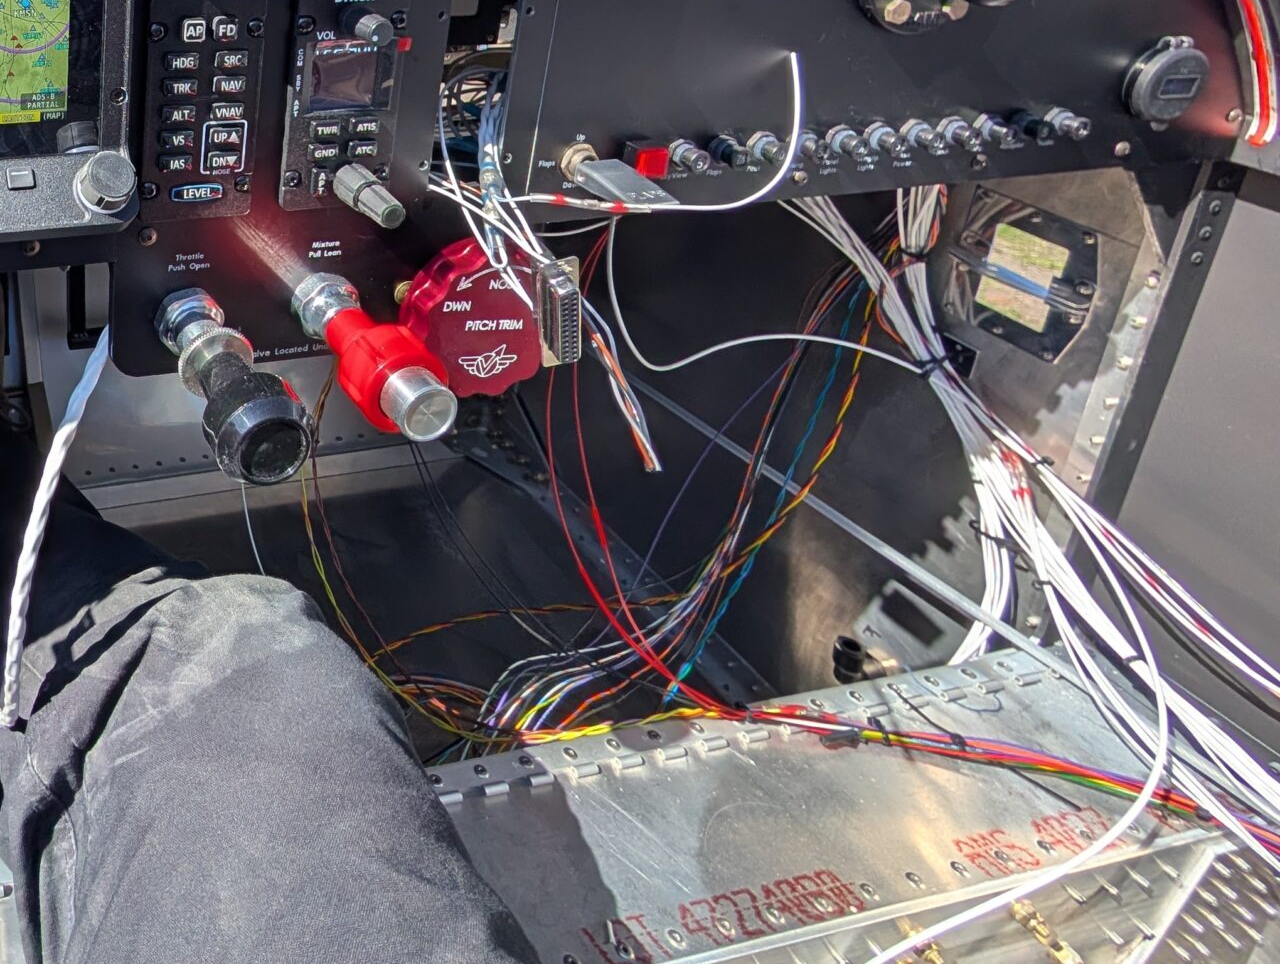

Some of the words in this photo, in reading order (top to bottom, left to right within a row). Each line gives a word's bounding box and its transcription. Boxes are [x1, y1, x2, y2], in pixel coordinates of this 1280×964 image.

[186, 26, 203, 37] AP
[219, 24, 236, 36] FD
[316, 31, 337, 41] VOL
[172, 56, 195, 69] HDG
[224, 54, 242, 66] SRC
[296, 48, 304, 67] COM
[173, 83, 191, 94] TRK
[221, 80, 242, 91] NAV
[27, 101, 59, 109] PARTIAL
[43, 112, 65, 121] (MAP)
[172, 109, 190, 121] ALT
[215, 106, 242, 118] VNAV
[316, 126, 338, 136] TWR
[356, 122, 377, 132] ATIS
[172, 135, 185, 146] VS
[213, 132, 228, 143] UP
[314, 147, 336, 158] GND
[355, 145, 373, 155] ATC
[170, 159, 185, 170] IAS
[212, 156, 226, 167] DN
[538, 160, 555, 168] Flaps
[857, 164, 875, 172] Lights
[183, 188, 212, 199] LEVEL
[311, 240, 341, 249] Mixture
[175, 252, 205, 262] Throttle
[308, 250, 322, 259] Pull
[324, 249, 342, 258] Lean
[168, 264, 186, 273] Push
[189, 262, 210, 272] Open
[443, 301, 472, 312] DWN
[465, 320, 496, 331] PITCH
[498, 319, 523, 330] TRIM
[253, 350, 271, 358] alve
[274, 344, 309, 355] Located
